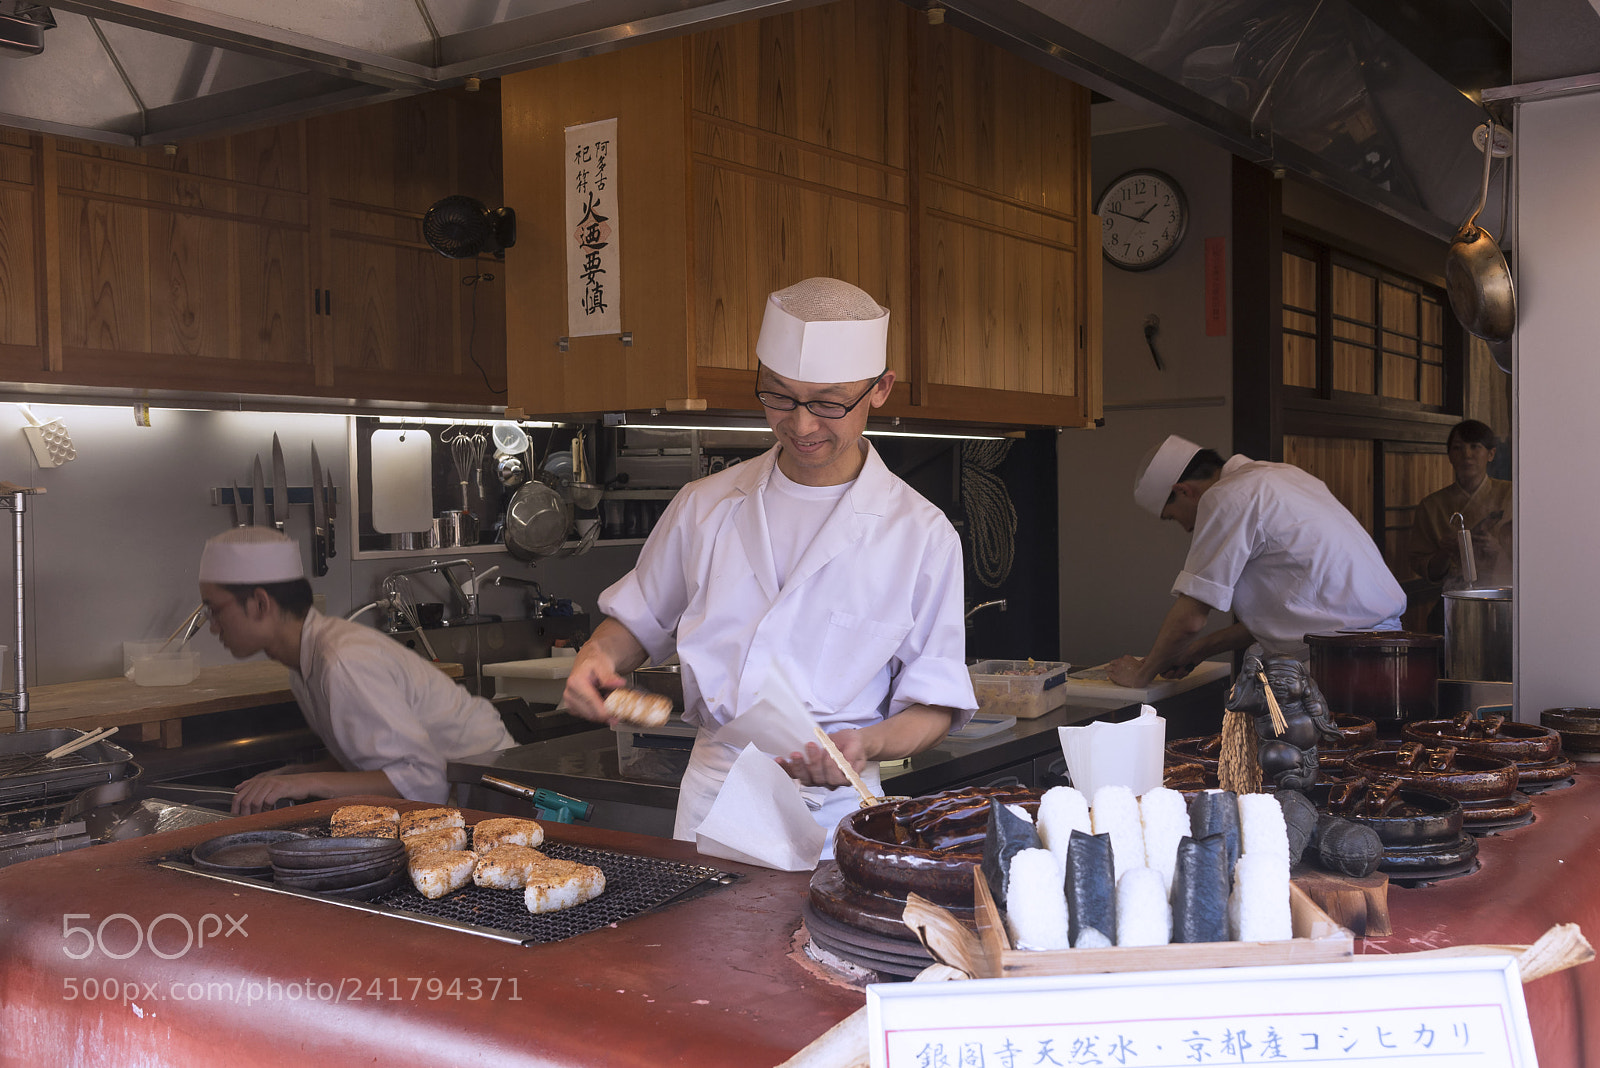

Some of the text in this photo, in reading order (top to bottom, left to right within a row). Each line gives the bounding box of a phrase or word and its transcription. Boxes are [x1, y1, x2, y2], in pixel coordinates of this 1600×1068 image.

[595, 140, 610, 191] 阿多古
[1122, 189, 1131, 201] 11
[1135, 182, 1146, 195] 12
[1111, 200, 1122, 213] 10
[1163, 194, 1170, 207] 2
[1168, 210, 1176, 224] 3
[1106, 217, 1114, 231] 9
[1111, 233, 1119, 246] 8
[1161, 227, 1169, 240] 4
[1123, 243, 1131, 256] 7
[1136, 245, 1145, 258] 6
[1152, 239, 1159, 253] 5
[577, 191, 609, 316] 火迺要慎
